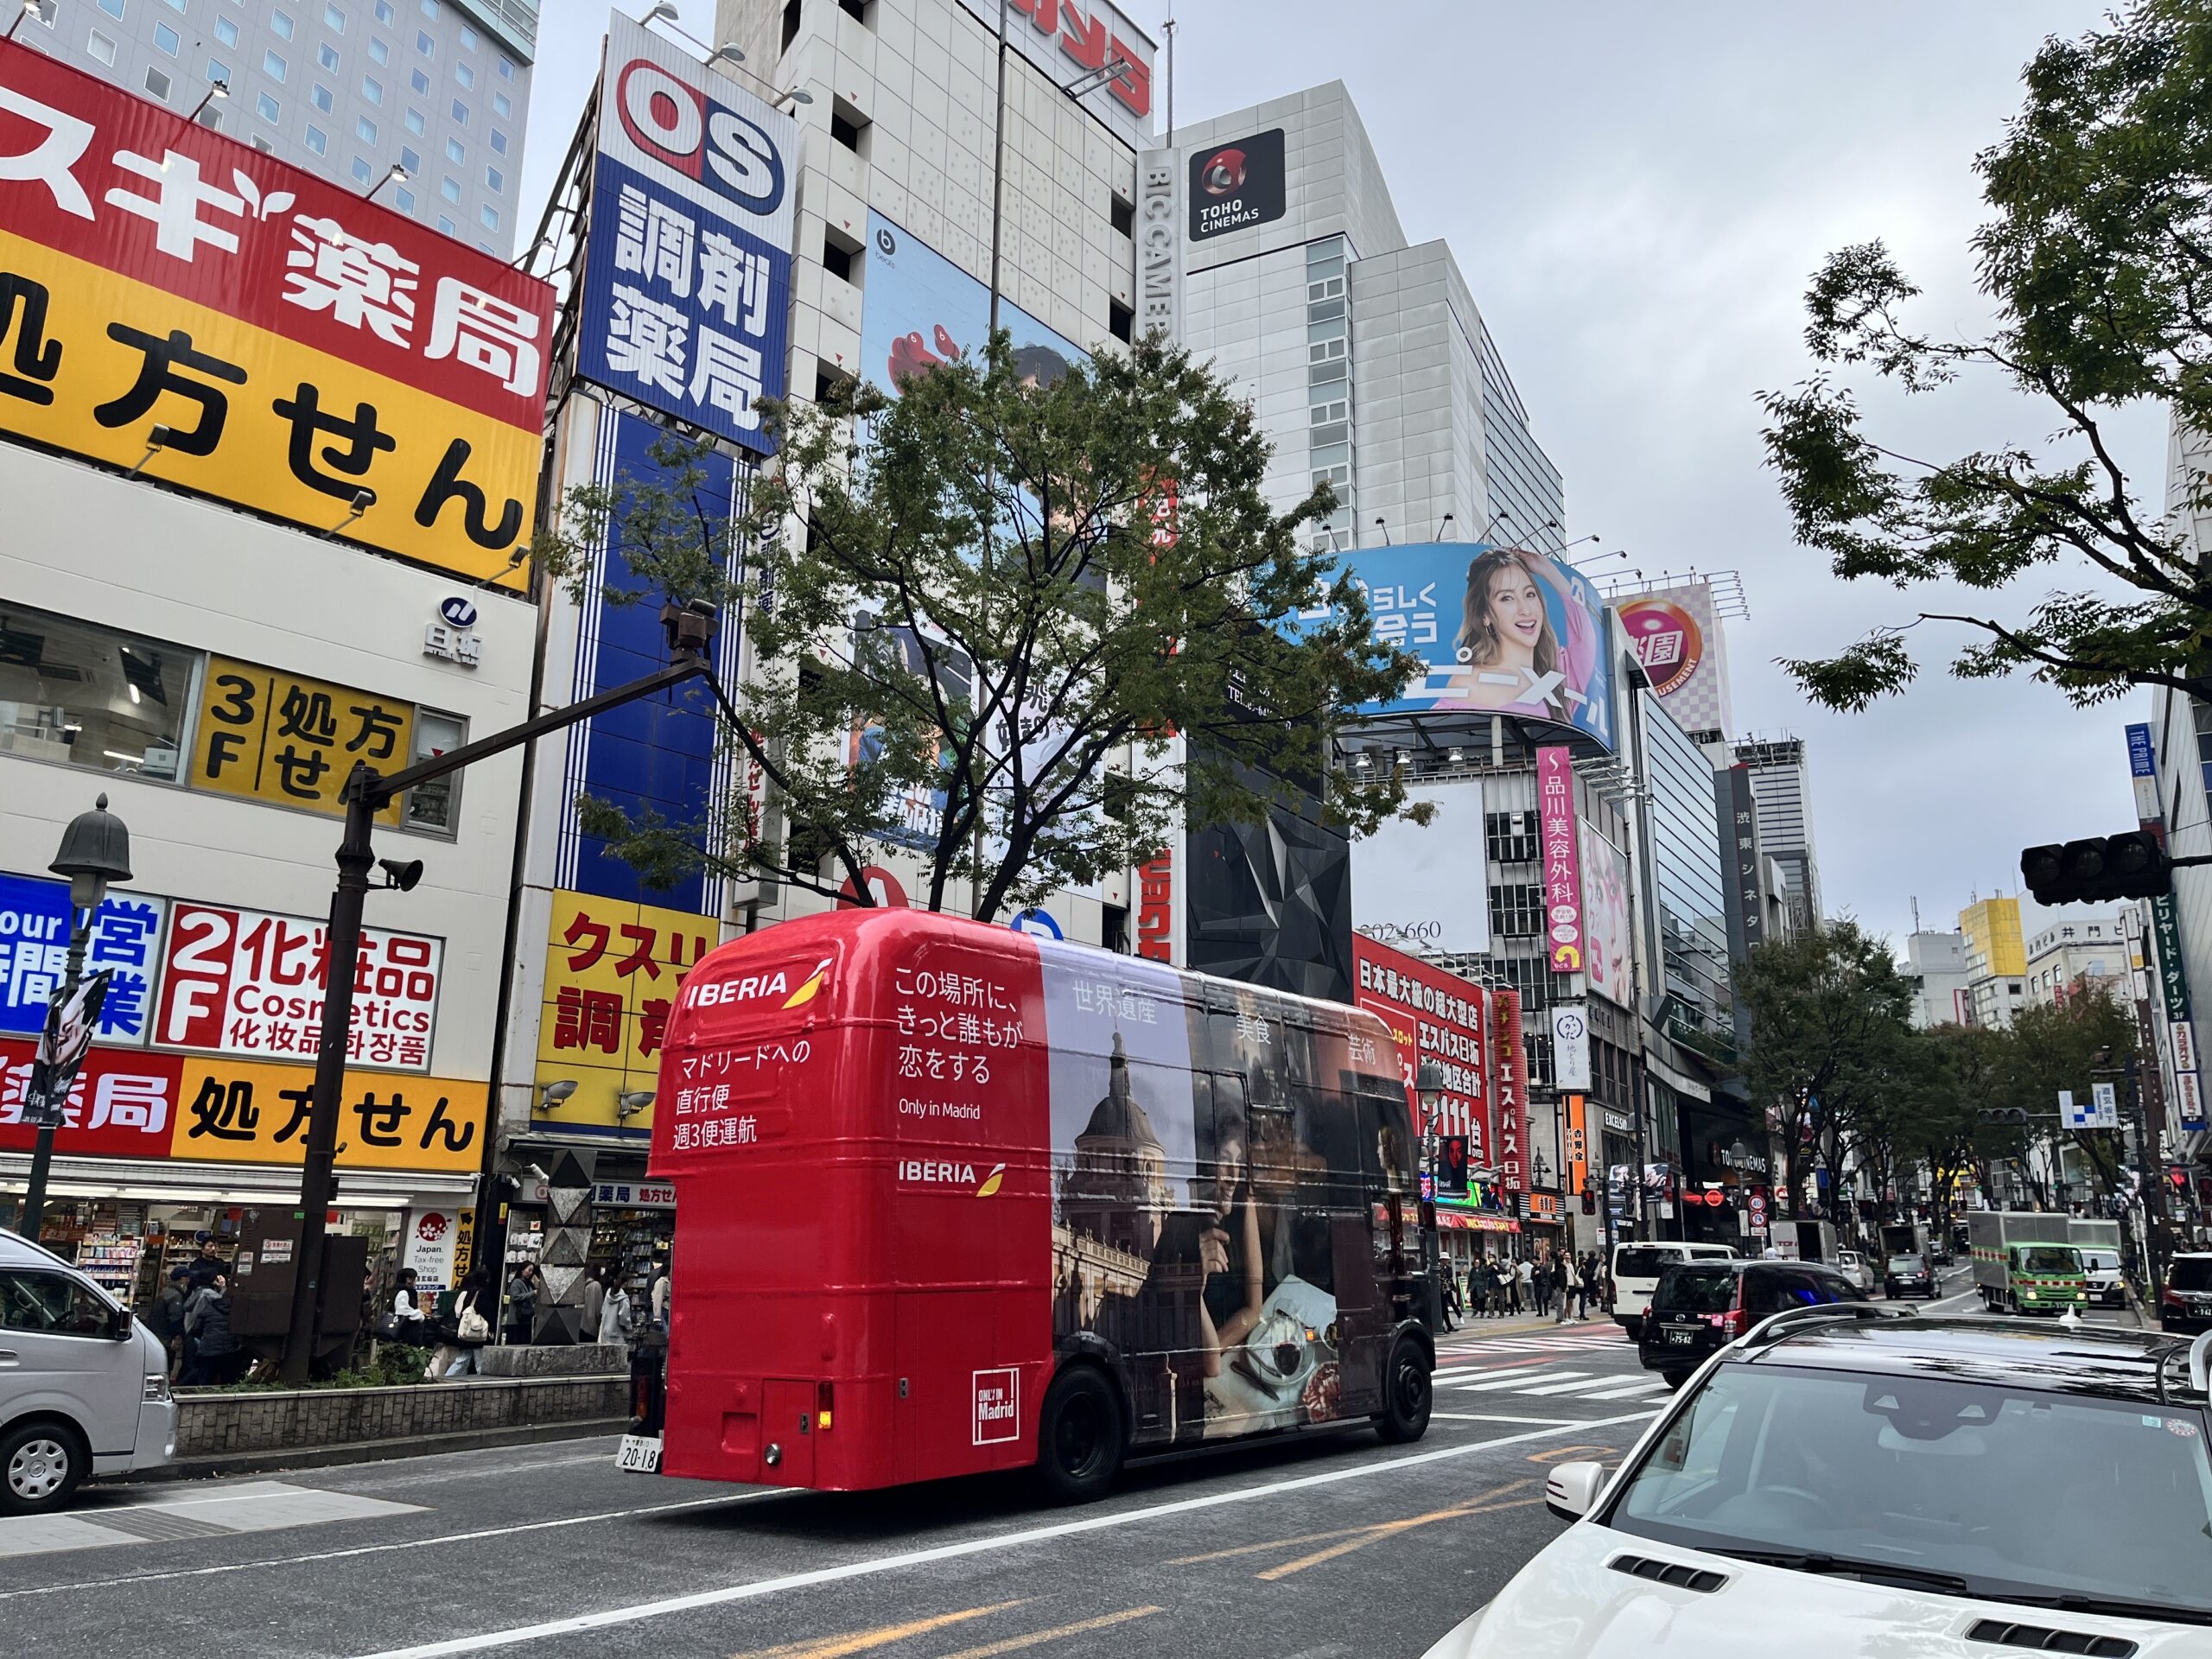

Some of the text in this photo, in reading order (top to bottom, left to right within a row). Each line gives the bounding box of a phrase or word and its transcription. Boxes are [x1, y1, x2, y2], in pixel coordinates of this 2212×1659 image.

[617, 59, 785, 216] OS
[1200, 199, 1243, 221] TOHO
[1200, 207, 1260, 233] CINEMAS
[614, 183, 771, 338] 調剤
[606, 282, 762, 431] 薬局
[277, 684, 404, 760] 処方
[2129, 729, 2147, 747] THE
[274, 744, 368, 808] せ
[2132, 747, 2152, 775] PRIME
[1544, 775, 1575, 904] 品川美容外科
[2156, 893, 2184, 1010] ビリヤード・ダーツ
[167, 911, 232, 1043] 2F
[688, 971, 787, 1009] IBERIA
[894, 966, 1020, 1013] この場所に、
[1358, 957, 1479, 1033] 日本最大級の超大型店
[1072, 979, 1159, 1026] 世界遺産
[896, 1004, 1024, 1050] きっと誰もが
[1418, 1020, 1480, 1066] エスパス日拓
[681, 1039, 811, 1080] マドリードへの
[898, 1045, 991, 1085] 恋をする
[676, 1083, 731, 1116] 直行便
[899, 1098, 981, 1121] Only in Madrid
[672, 1116, 758, 1151] 週3便運航
[1500, 1063, 1522, 1192] エスパス日拓
[898, 1160, 976, 1184] IBERIA
[414, 1255, 444, 1264] Tax-free
[416, 1245, 443, 1254] Japan.
[417, 1265, 438, 1274] Shop
[978, 1400, 1014, 1421] Madrid
